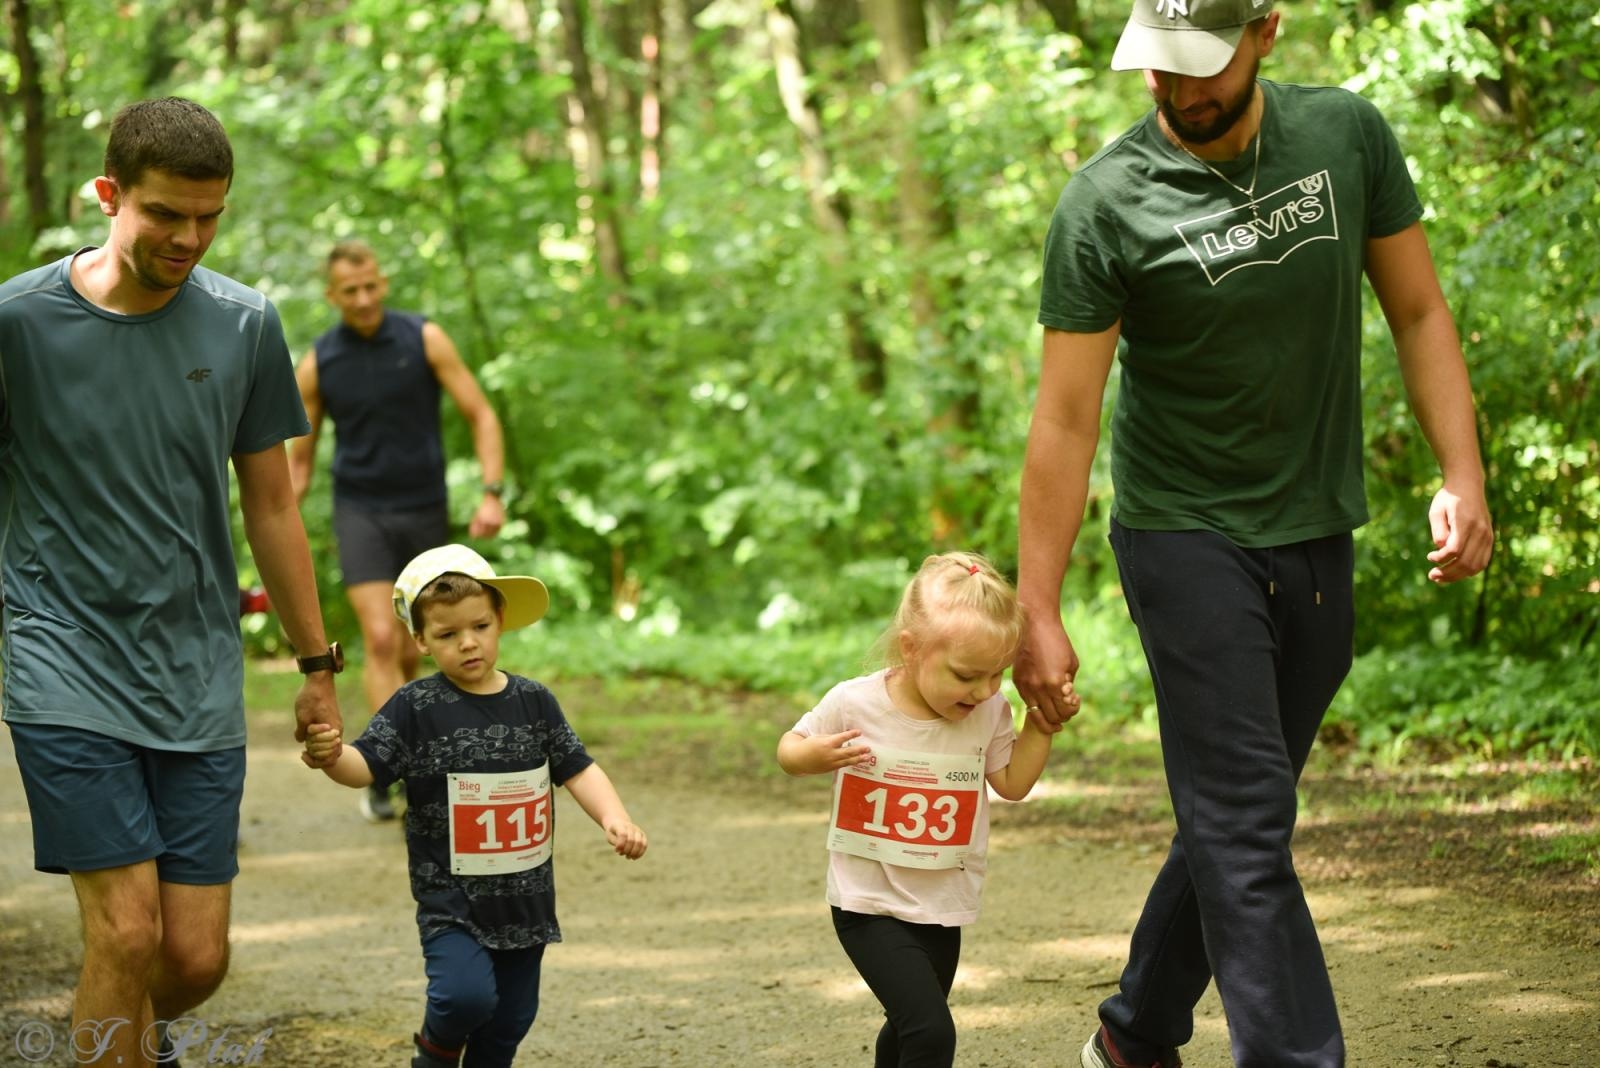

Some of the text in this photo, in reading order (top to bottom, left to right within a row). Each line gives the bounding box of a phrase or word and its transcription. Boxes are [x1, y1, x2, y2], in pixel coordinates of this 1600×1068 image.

[186, 368, 212, 383] 4F
[945, 771, 969, 782] 4500
[970, 772, 979, 781] M
[458, 780, 481, 793] Bieg
[863, 787, 959, 842] 133
[475, 799, 547, 849] 115
